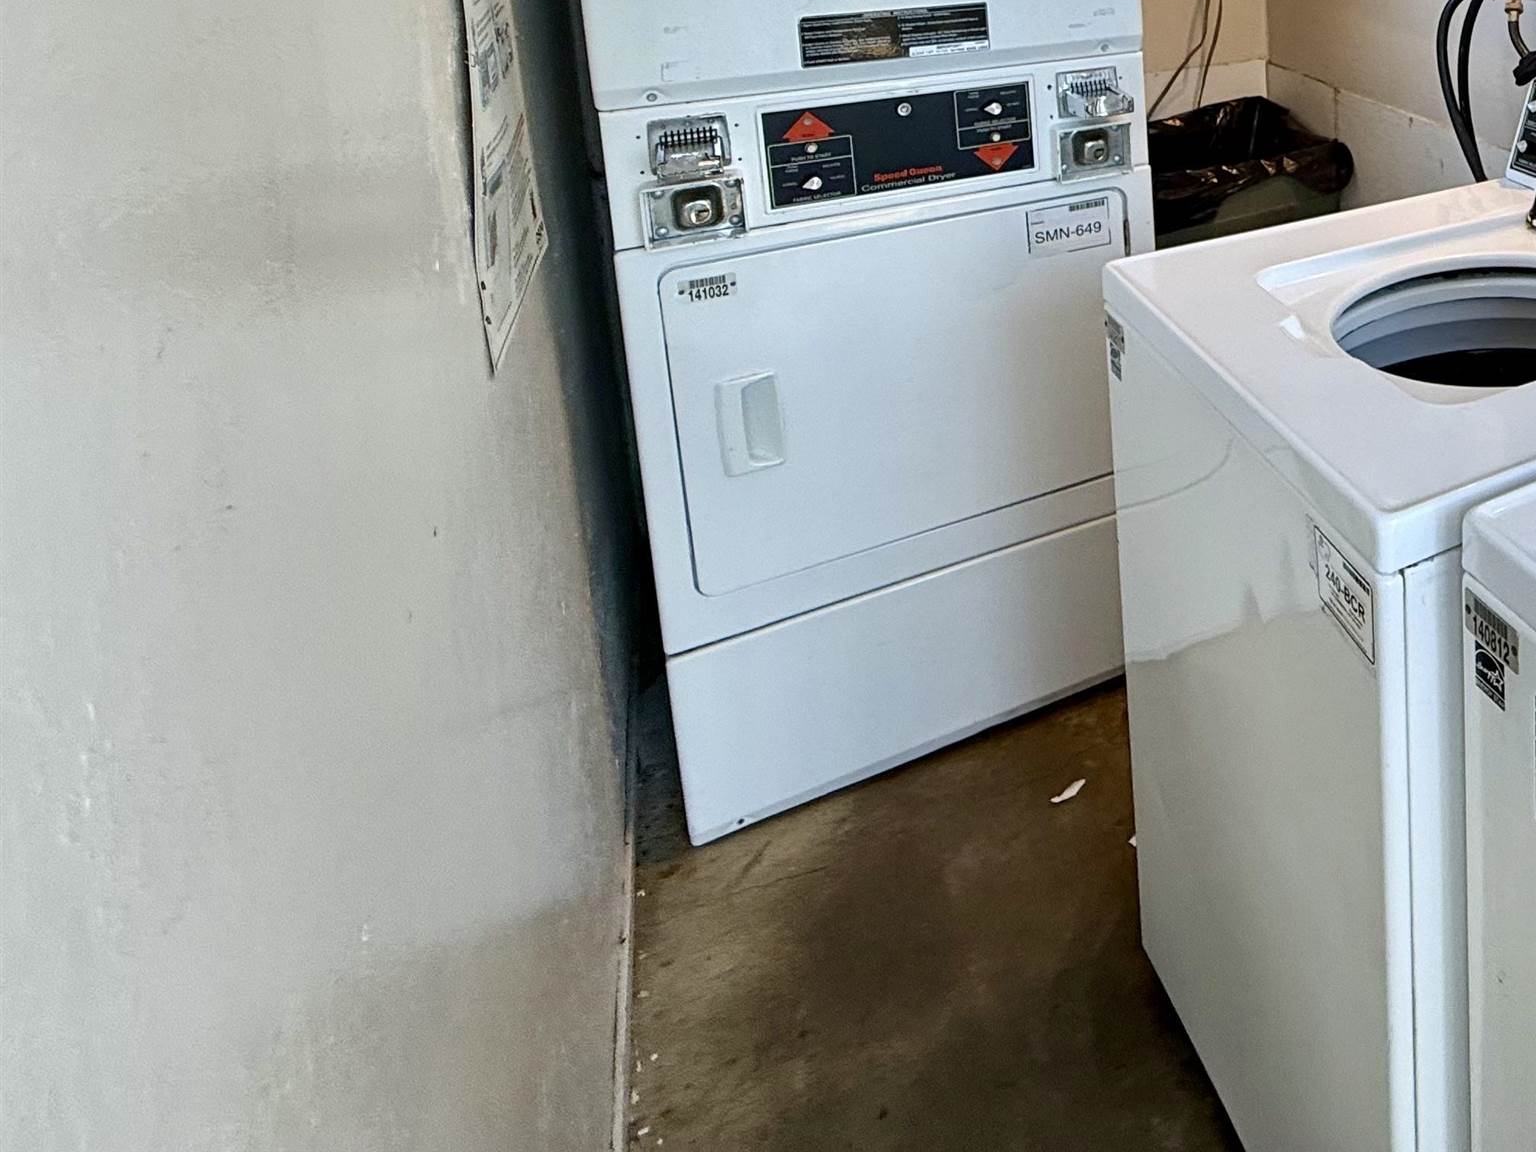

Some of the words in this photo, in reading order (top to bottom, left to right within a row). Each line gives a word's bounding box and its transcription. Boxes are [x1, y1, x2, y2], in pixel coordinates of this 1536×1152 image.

[861, 177, 926, 193] Commercial
[928, 171, 956, 184] Dryer
[874, 167, 907, 182] Speed
[1034, 220, 1102, 244] SMN-649
[688, 284, 729, 302] 141032
[1324, 563, 1366, 625] 240-BCR
[1473, 615, 1510, 665] 140812
